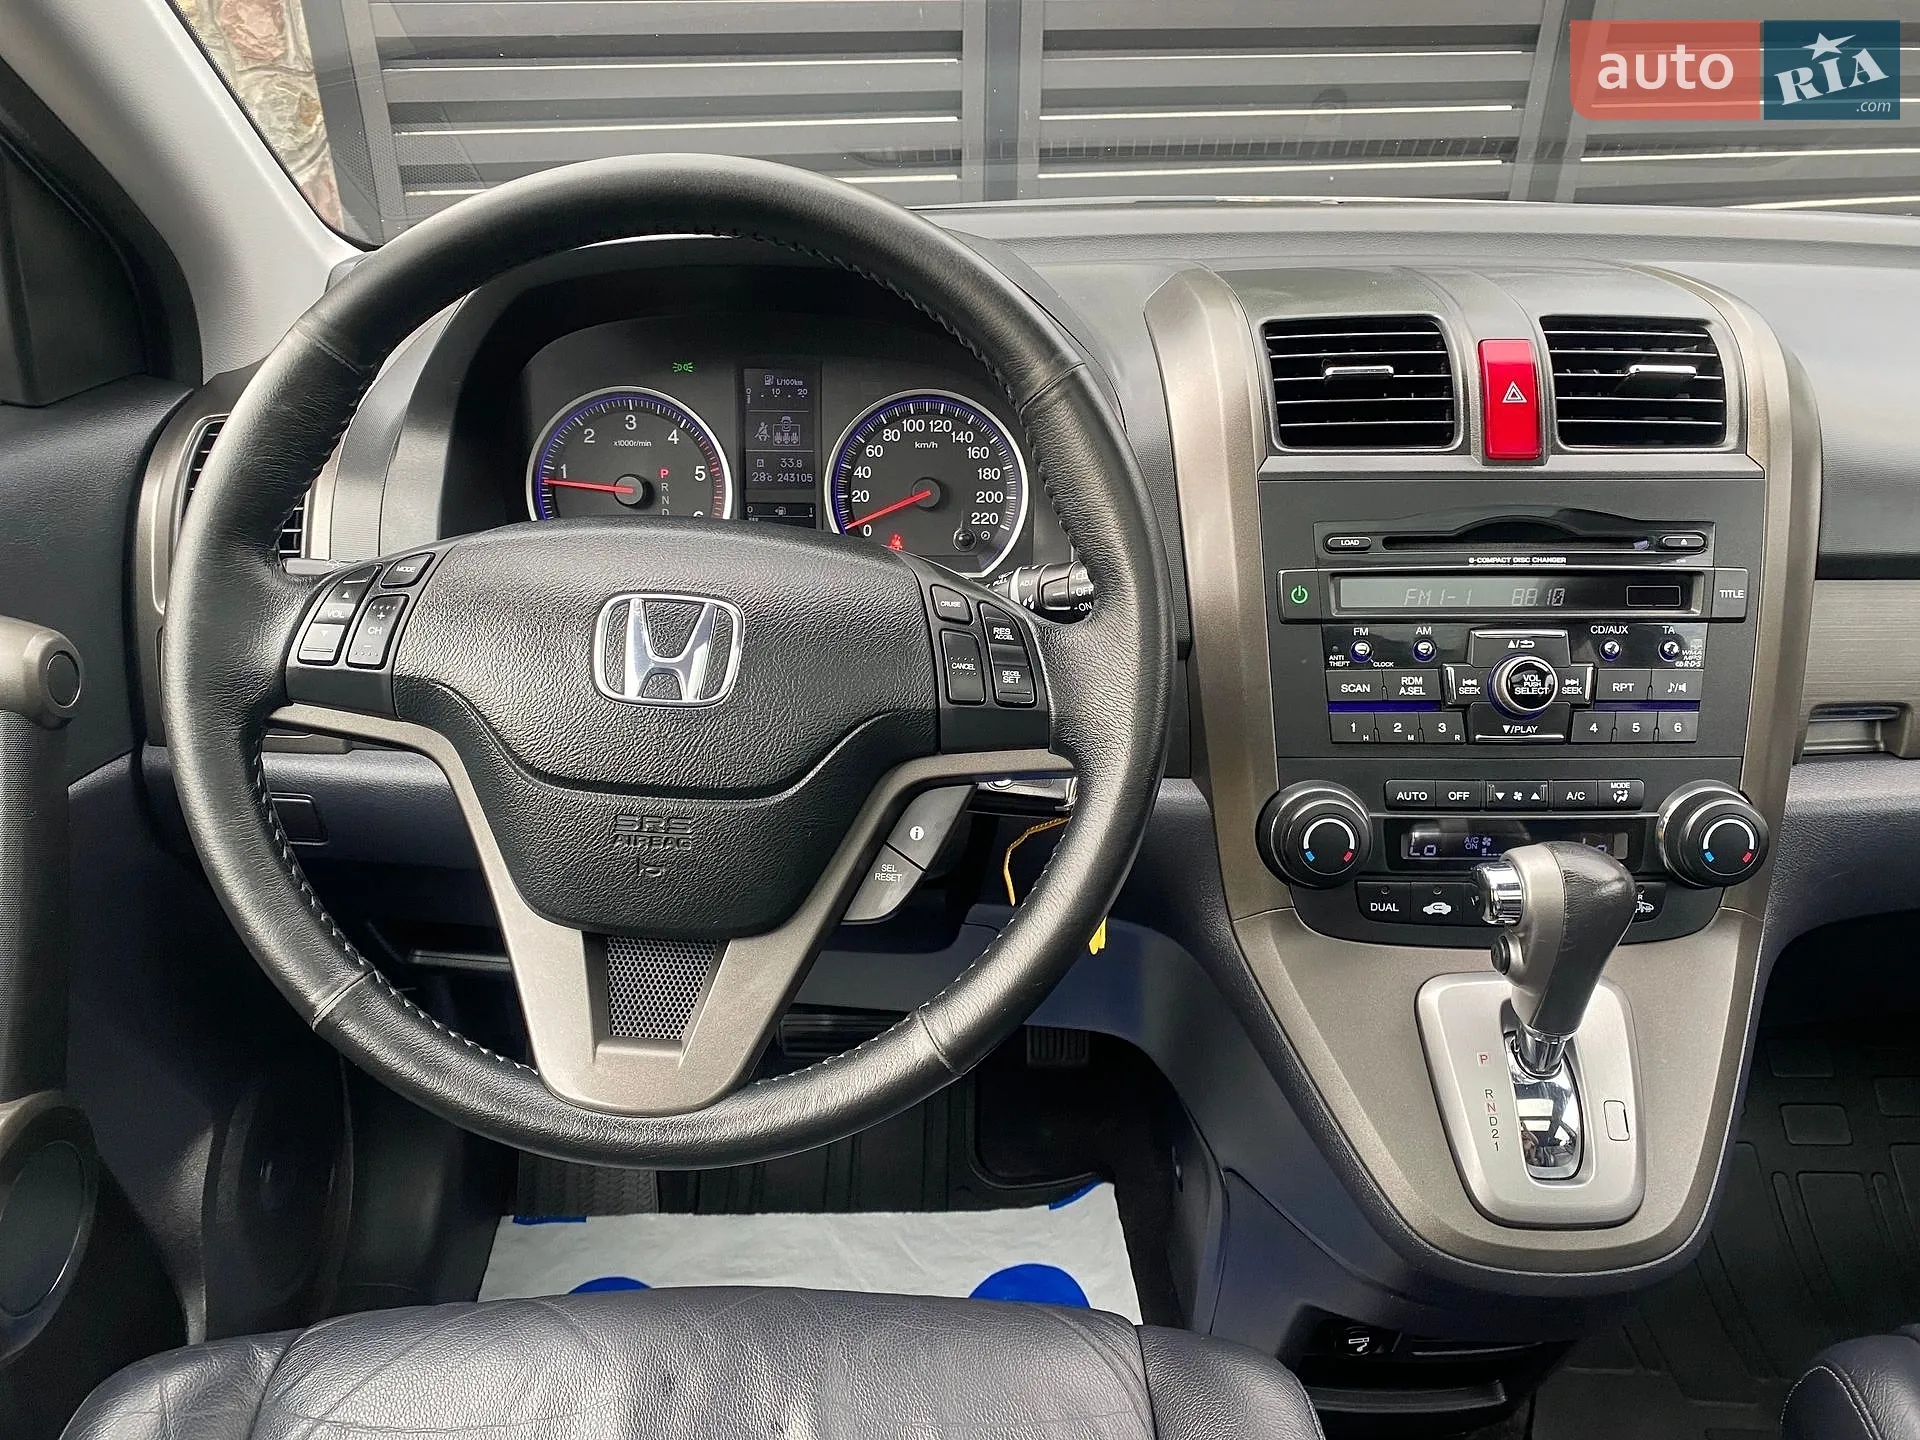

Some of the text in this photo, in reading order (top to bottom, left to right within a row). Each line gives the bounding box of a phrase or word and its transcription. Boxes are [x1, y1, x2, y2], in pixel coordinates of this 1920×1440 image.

[625, 415, 637, 430] 3
[902, 419, 925, 432] 100
[929, 420, 952, 433] 120
[584, 429, 595, 443] 2
[668, 430, 679, 444] 4
[882, 429, 901, 442] 80
[951, 431, 974, 444] 140
[914, 441, 938, 449] km/h
[866, 445, 883, 458] 60
[967, 447, 989, 460] 160
[780, 458, 802, 468] 33.8
[560, 464, 567, 479] 1
[659, 468, 670, 479] P
[694, 466, 706, 481] 5
[853, 466, 872, 479] 40
[977, 468, 1000, 481] 180
[777, 473, 813, 483] 243105
[662, 483, 669, 492] R
[851, 488, 869, 501] 20
[976, 491, 1003, 504] 200
[661, 496, 670, 504] N
[971, 512, 998, 525] 220
[863, 525, 872, 537] 0
[1720, 589, 1744, 598] TITLE
[1078, 602, 1092, 612] ON
[328, 610, 345, 619] VOL
[367, 627, 382, 635] CH
[993, 627, 1011, 635] RES
[1353, 627, 1369, 636] FM
[1415, 626, 1432, 635] AM
[1590, 625, 1629, 635] CD/AUX
[1662, 625, 1676, 635] TA
[1002, 676, 1020, 684] SET
[1401, 677, 1423, 685] RDM
[1523, 674, 1541, 682] VOL
[1340, 684, 1370, 693] SCAN
[1399, 687, 1426, 696] A.SEL
[1458, 686, 1481, 695] SEEK
[1514, 687, 1549, 695] SELECT
[1561, 686, 1583, 695] SEEK
[1612, 682, 1634, 692] RPT
[1350, 722, 1357, 733] 1
[1393, 722, 1402, 733] 2
[1438, 722, 1447, 733] 3
[1589, 722, 1598, 733] 4
[1632, 722, 1641, 733] 5
[1673, 722, 1683, 733] 6
[1396, 791, 1428, 801] AUTO
[1448, 791, 1470, 801] OFF
[1566, 790, 1586, 801] A/C
[615, 814, 692, 834] SRS
[614, 836, 692, 851] AIRBAG
[881, 864, 897, 872] SEL
[874, 872, 902, 882] RESET
[1370, 902, 1400, 912] DUAL
[1479, 1054, 1488, 1064] P
[1484, 1089, 1494, 1099] R
[1487, 1102, 1496, 1112] N
[1489, 1116, 1498, 1126] D
[1491, 1129, 1499, 1138] 2
[1494, 1141, 1499, 1151] 1
